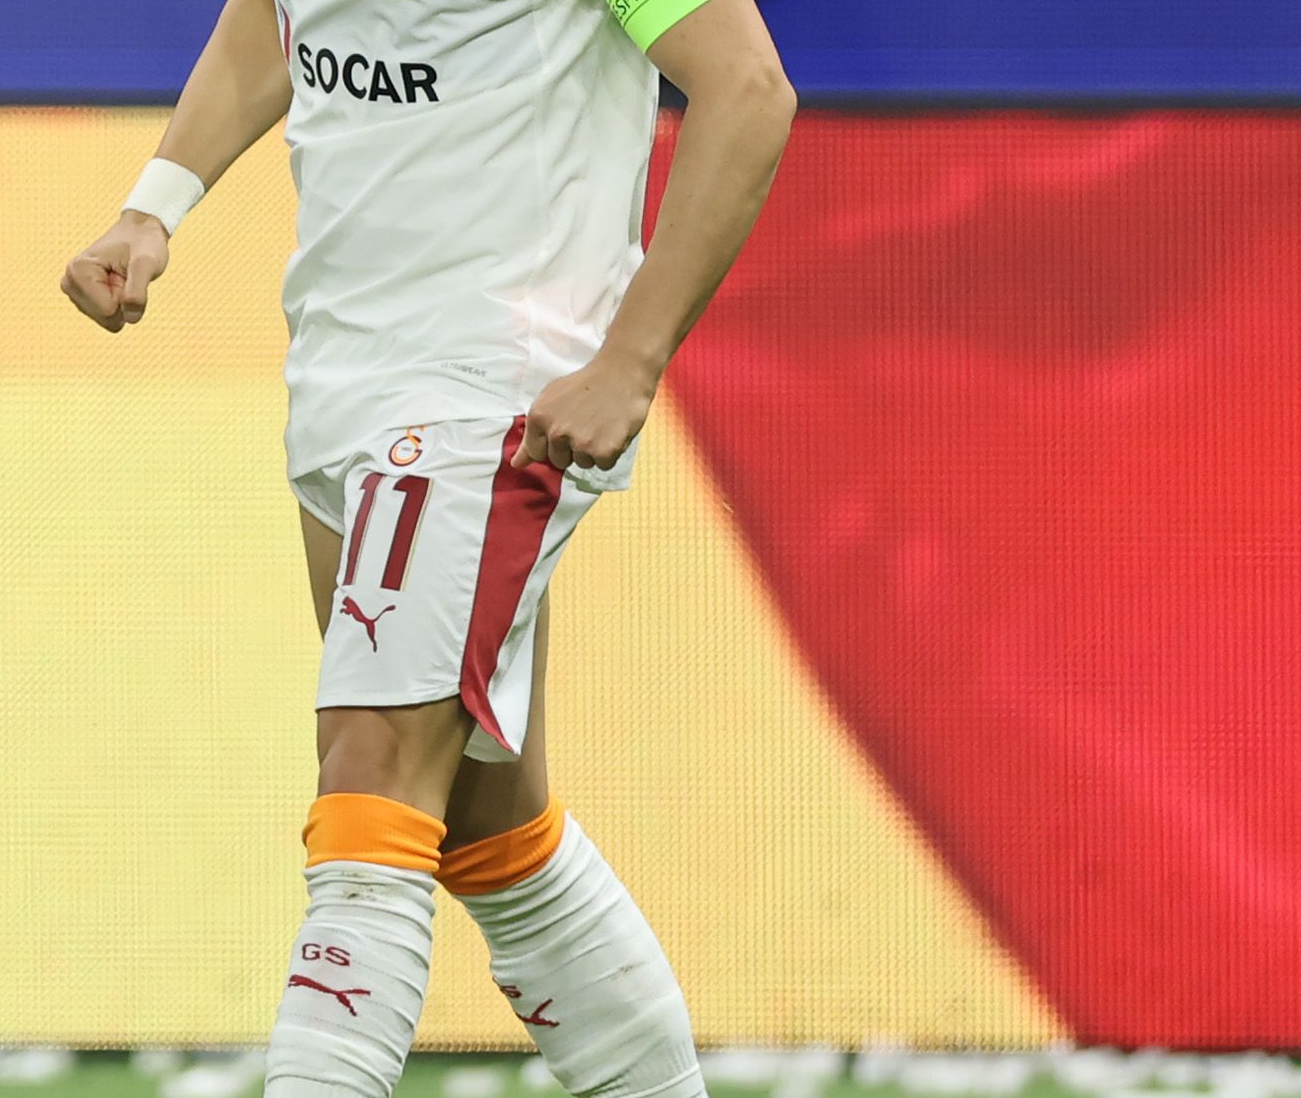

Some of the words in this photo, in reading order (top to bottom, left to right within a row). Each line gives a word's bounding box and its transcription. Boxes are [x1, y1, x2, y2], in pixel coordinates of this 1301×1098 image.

[298, 43, 439, 103] SOCAR
[342, 472, 434, 592] 11
[301, 943, 351, 967] GS
